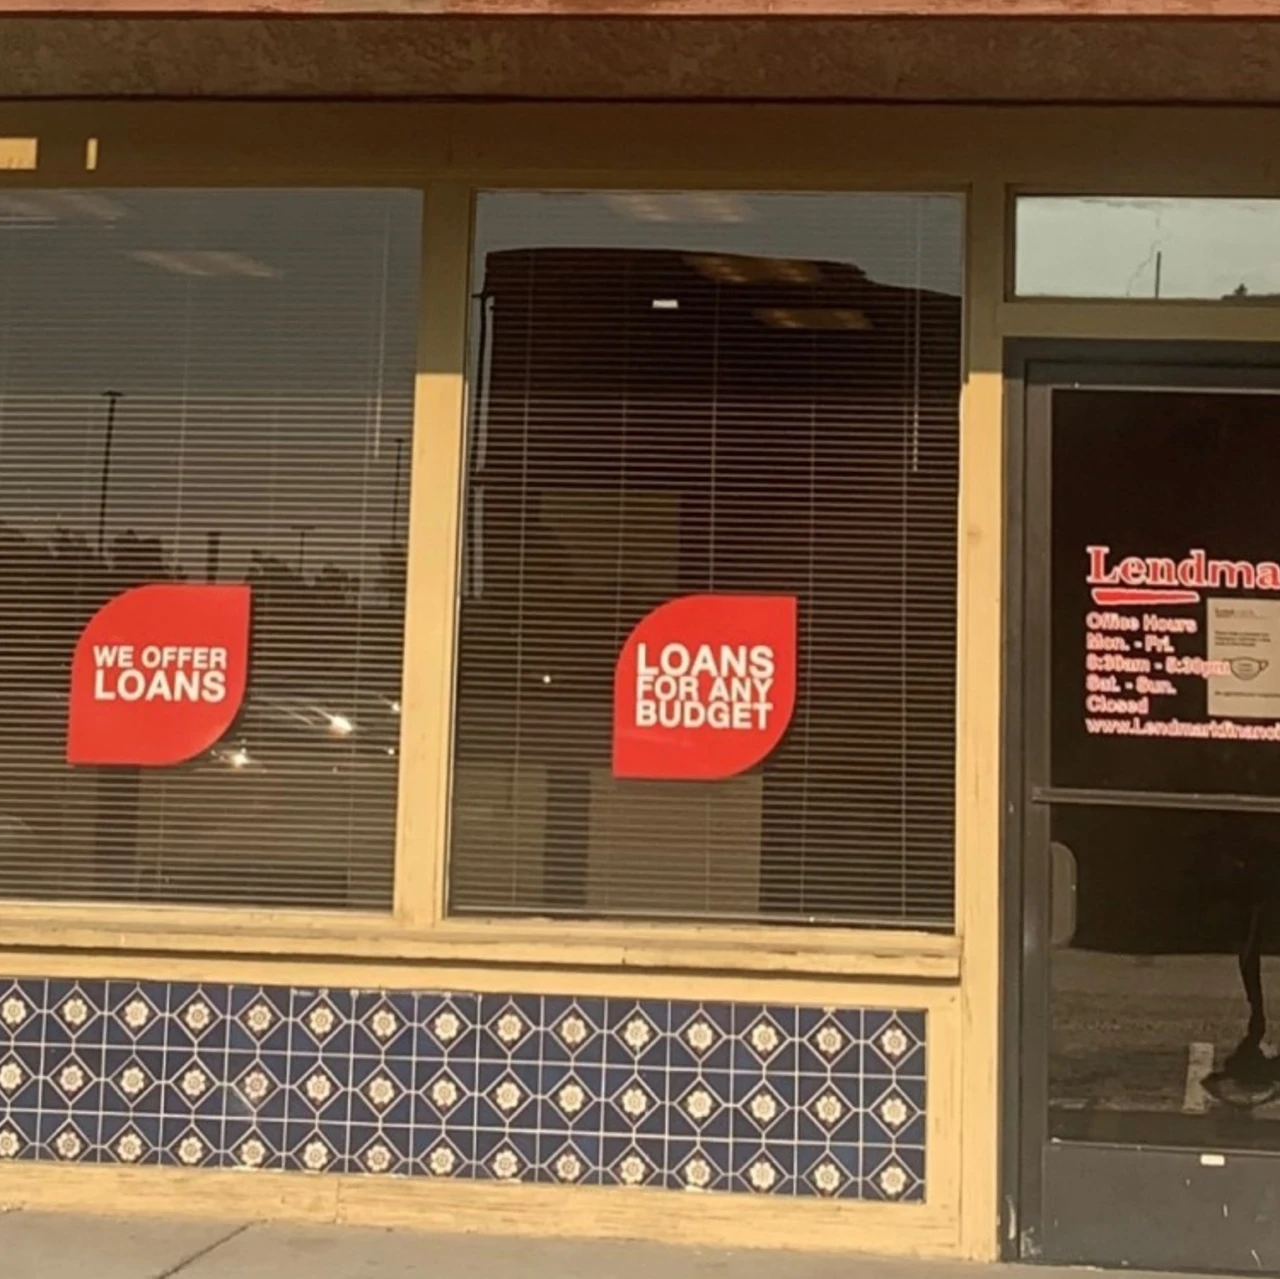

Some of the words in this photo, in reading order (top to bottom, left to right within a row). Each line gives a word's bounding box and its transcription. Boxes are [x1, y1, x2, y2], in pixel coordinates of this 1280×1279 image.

[1086, 611, 1140, 631] Office
[1143, 614, 1198, 633] Hours
[1086, 631, 1131, 651] Mon.
[1144, 634, 1175, 653] Fri.
[93, 645, 133, 668] WE
[141, 645, 227, 670] OFFER
[636, 643, 775, 677] LOANS
[93, 669, 227, 703] LOANS
[636, 675, 699, 701] FOR
[708, 677, 773, 703] ANY
[635, 700, 773, 730] BUDGET
[1086, 694, 1149, 714] Closed
